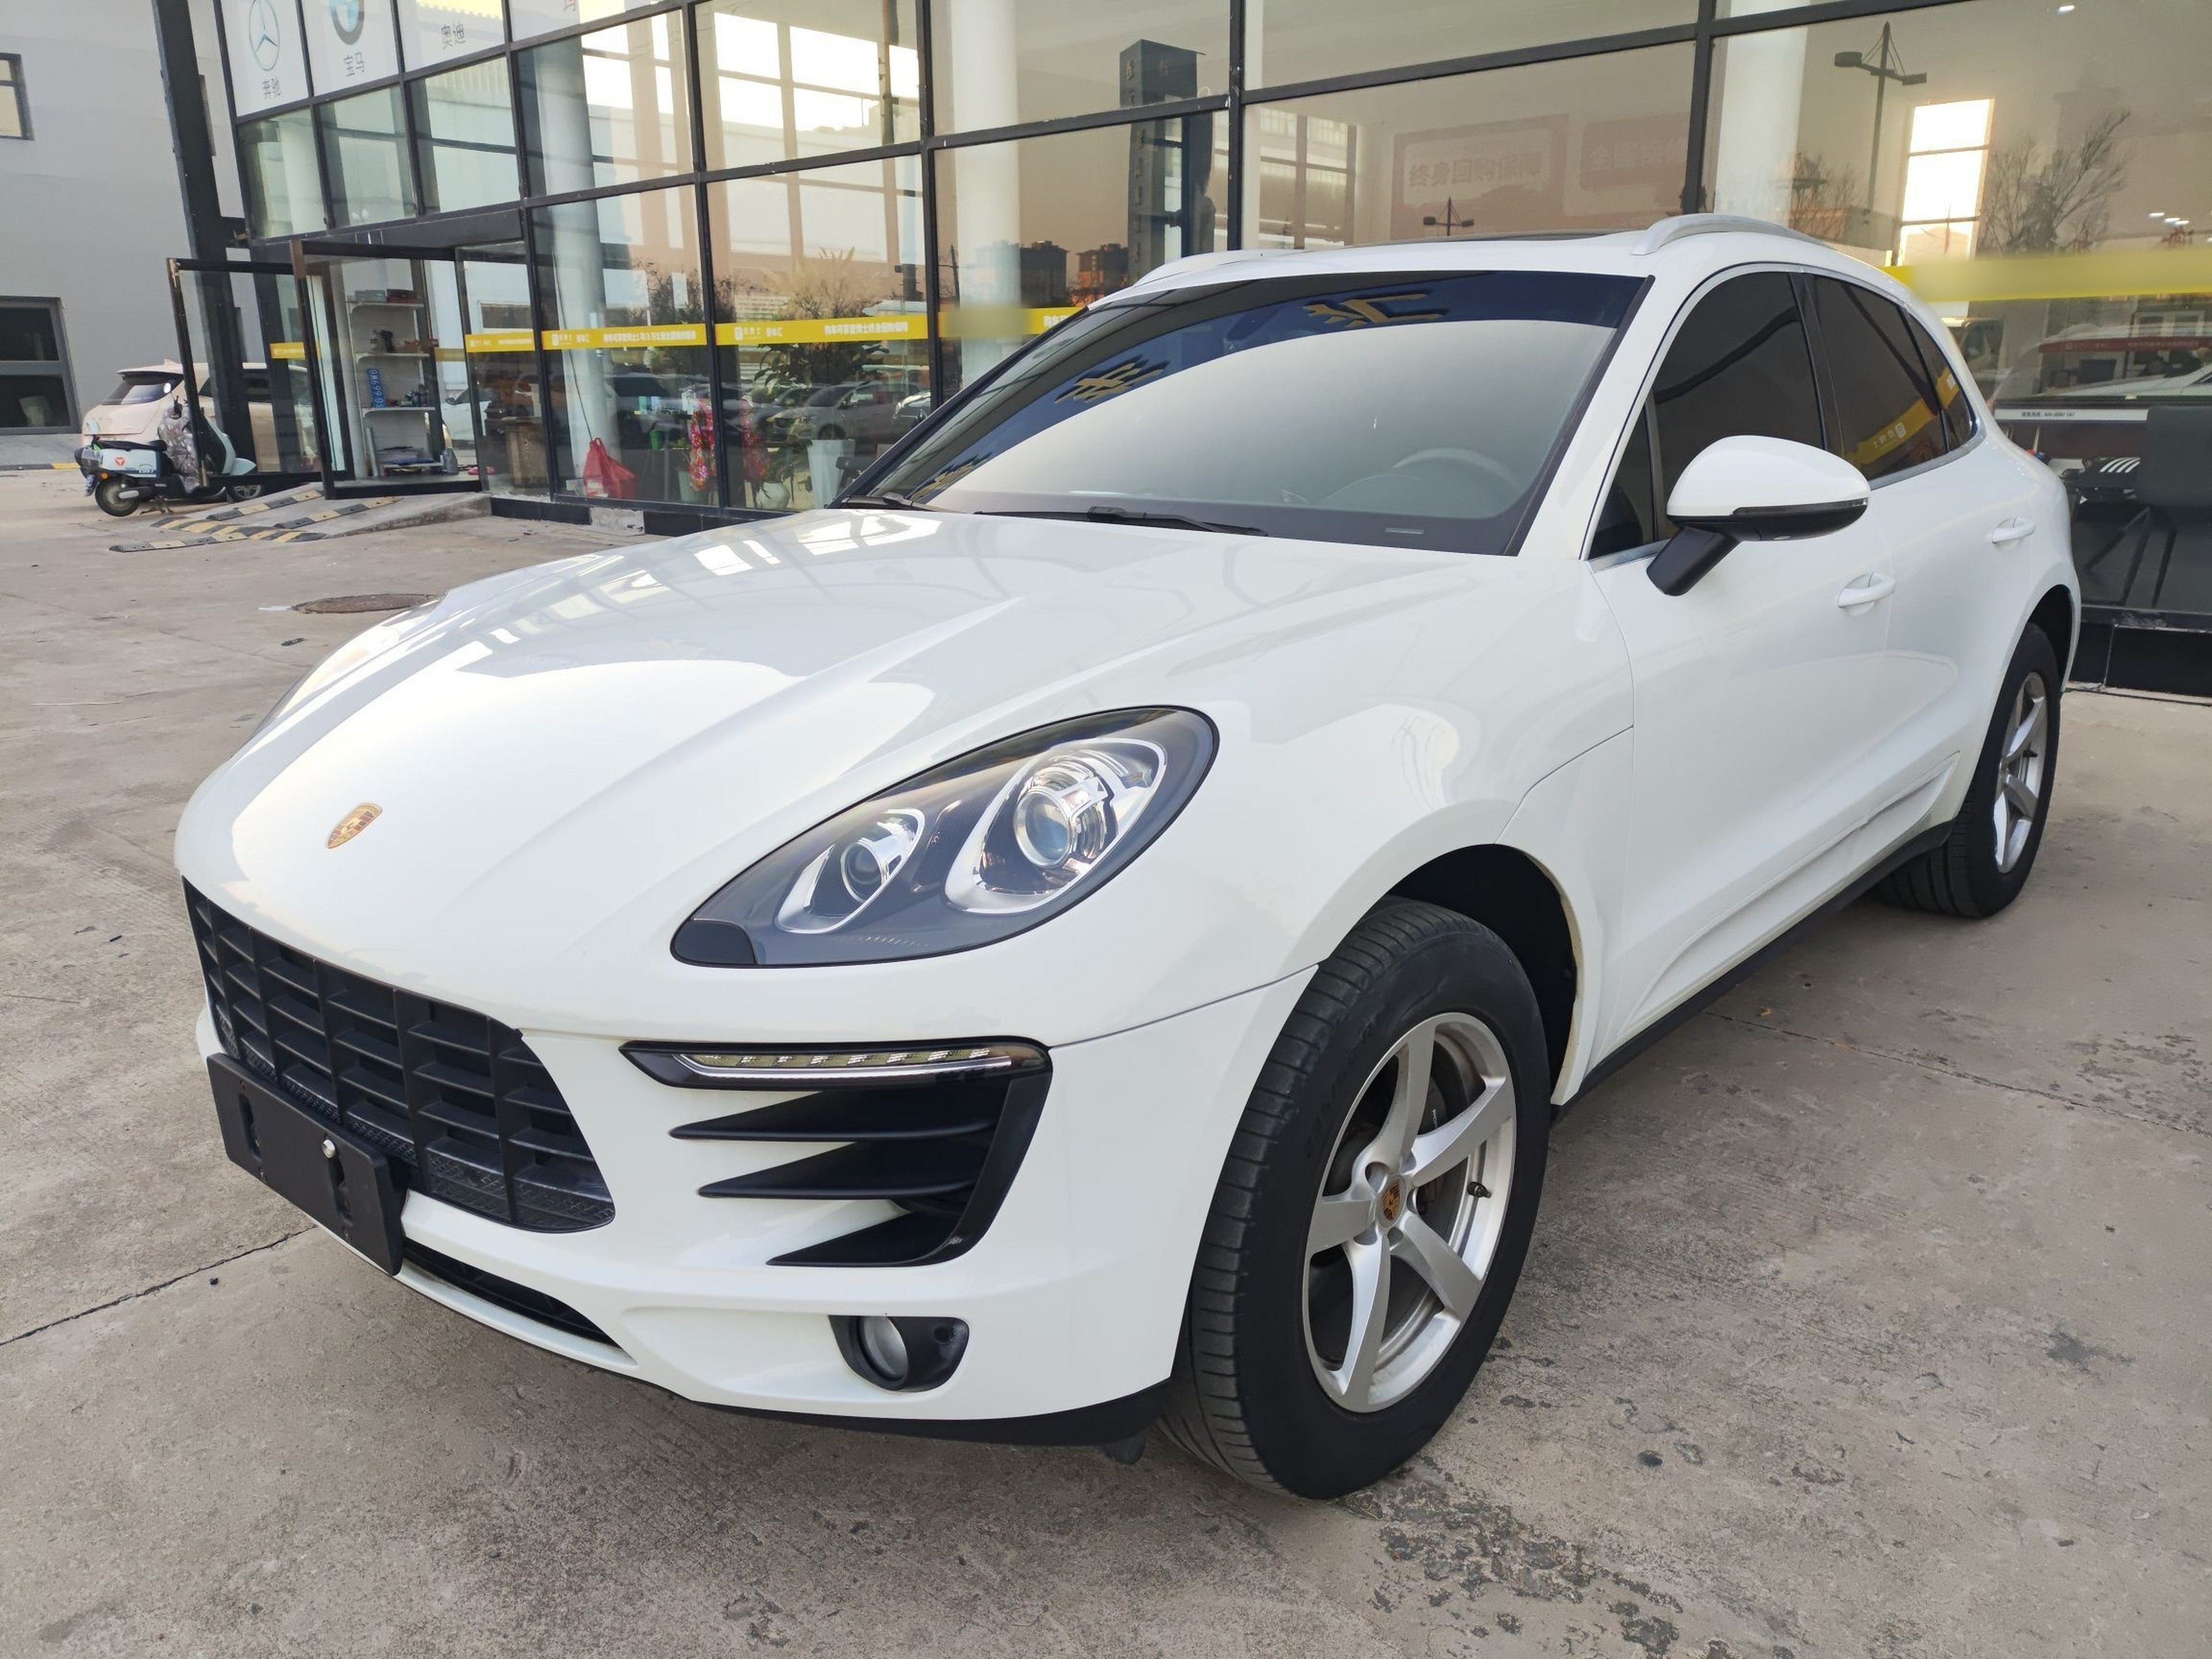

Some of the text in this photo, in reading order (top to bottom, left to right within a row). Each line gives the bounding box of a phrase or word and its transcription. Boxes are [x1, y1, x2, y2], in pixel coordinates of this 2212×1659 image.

[441, 21, 467, 50] 奥迪
[344, 52, 365, 77] 宝马
[262, 77, 282, 100] 奔驰
